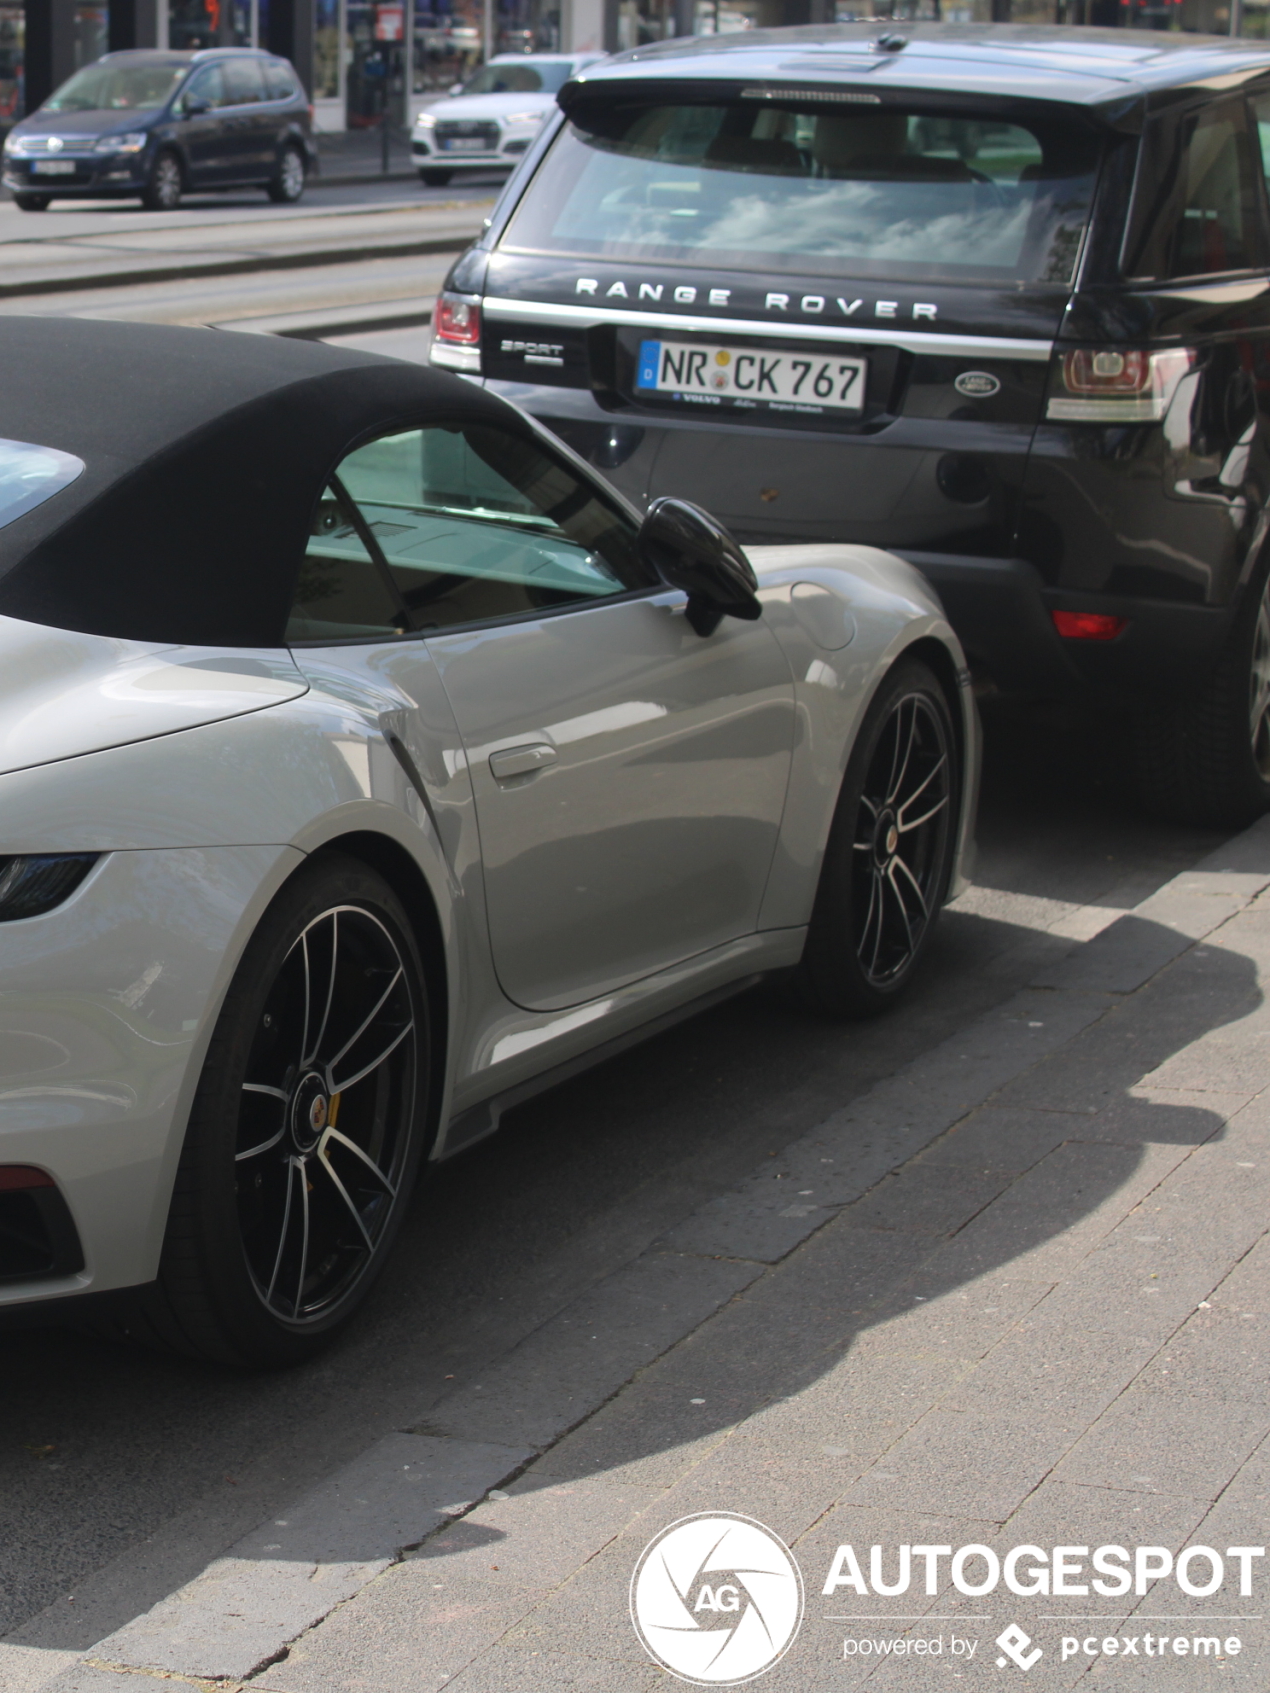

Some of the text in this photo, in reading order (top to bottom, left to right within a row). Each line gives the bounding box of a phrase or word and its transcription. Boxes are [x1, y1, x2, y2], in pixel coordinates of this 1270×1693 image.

[576, 278, 938, 319] RANGE ROVER
[500, 340, 564, 356] SPORT
[644, 369, 652, 380] D
[661, 348, 860, 400] NR CK 767
[683, 394, 721, 405] VOLVO
